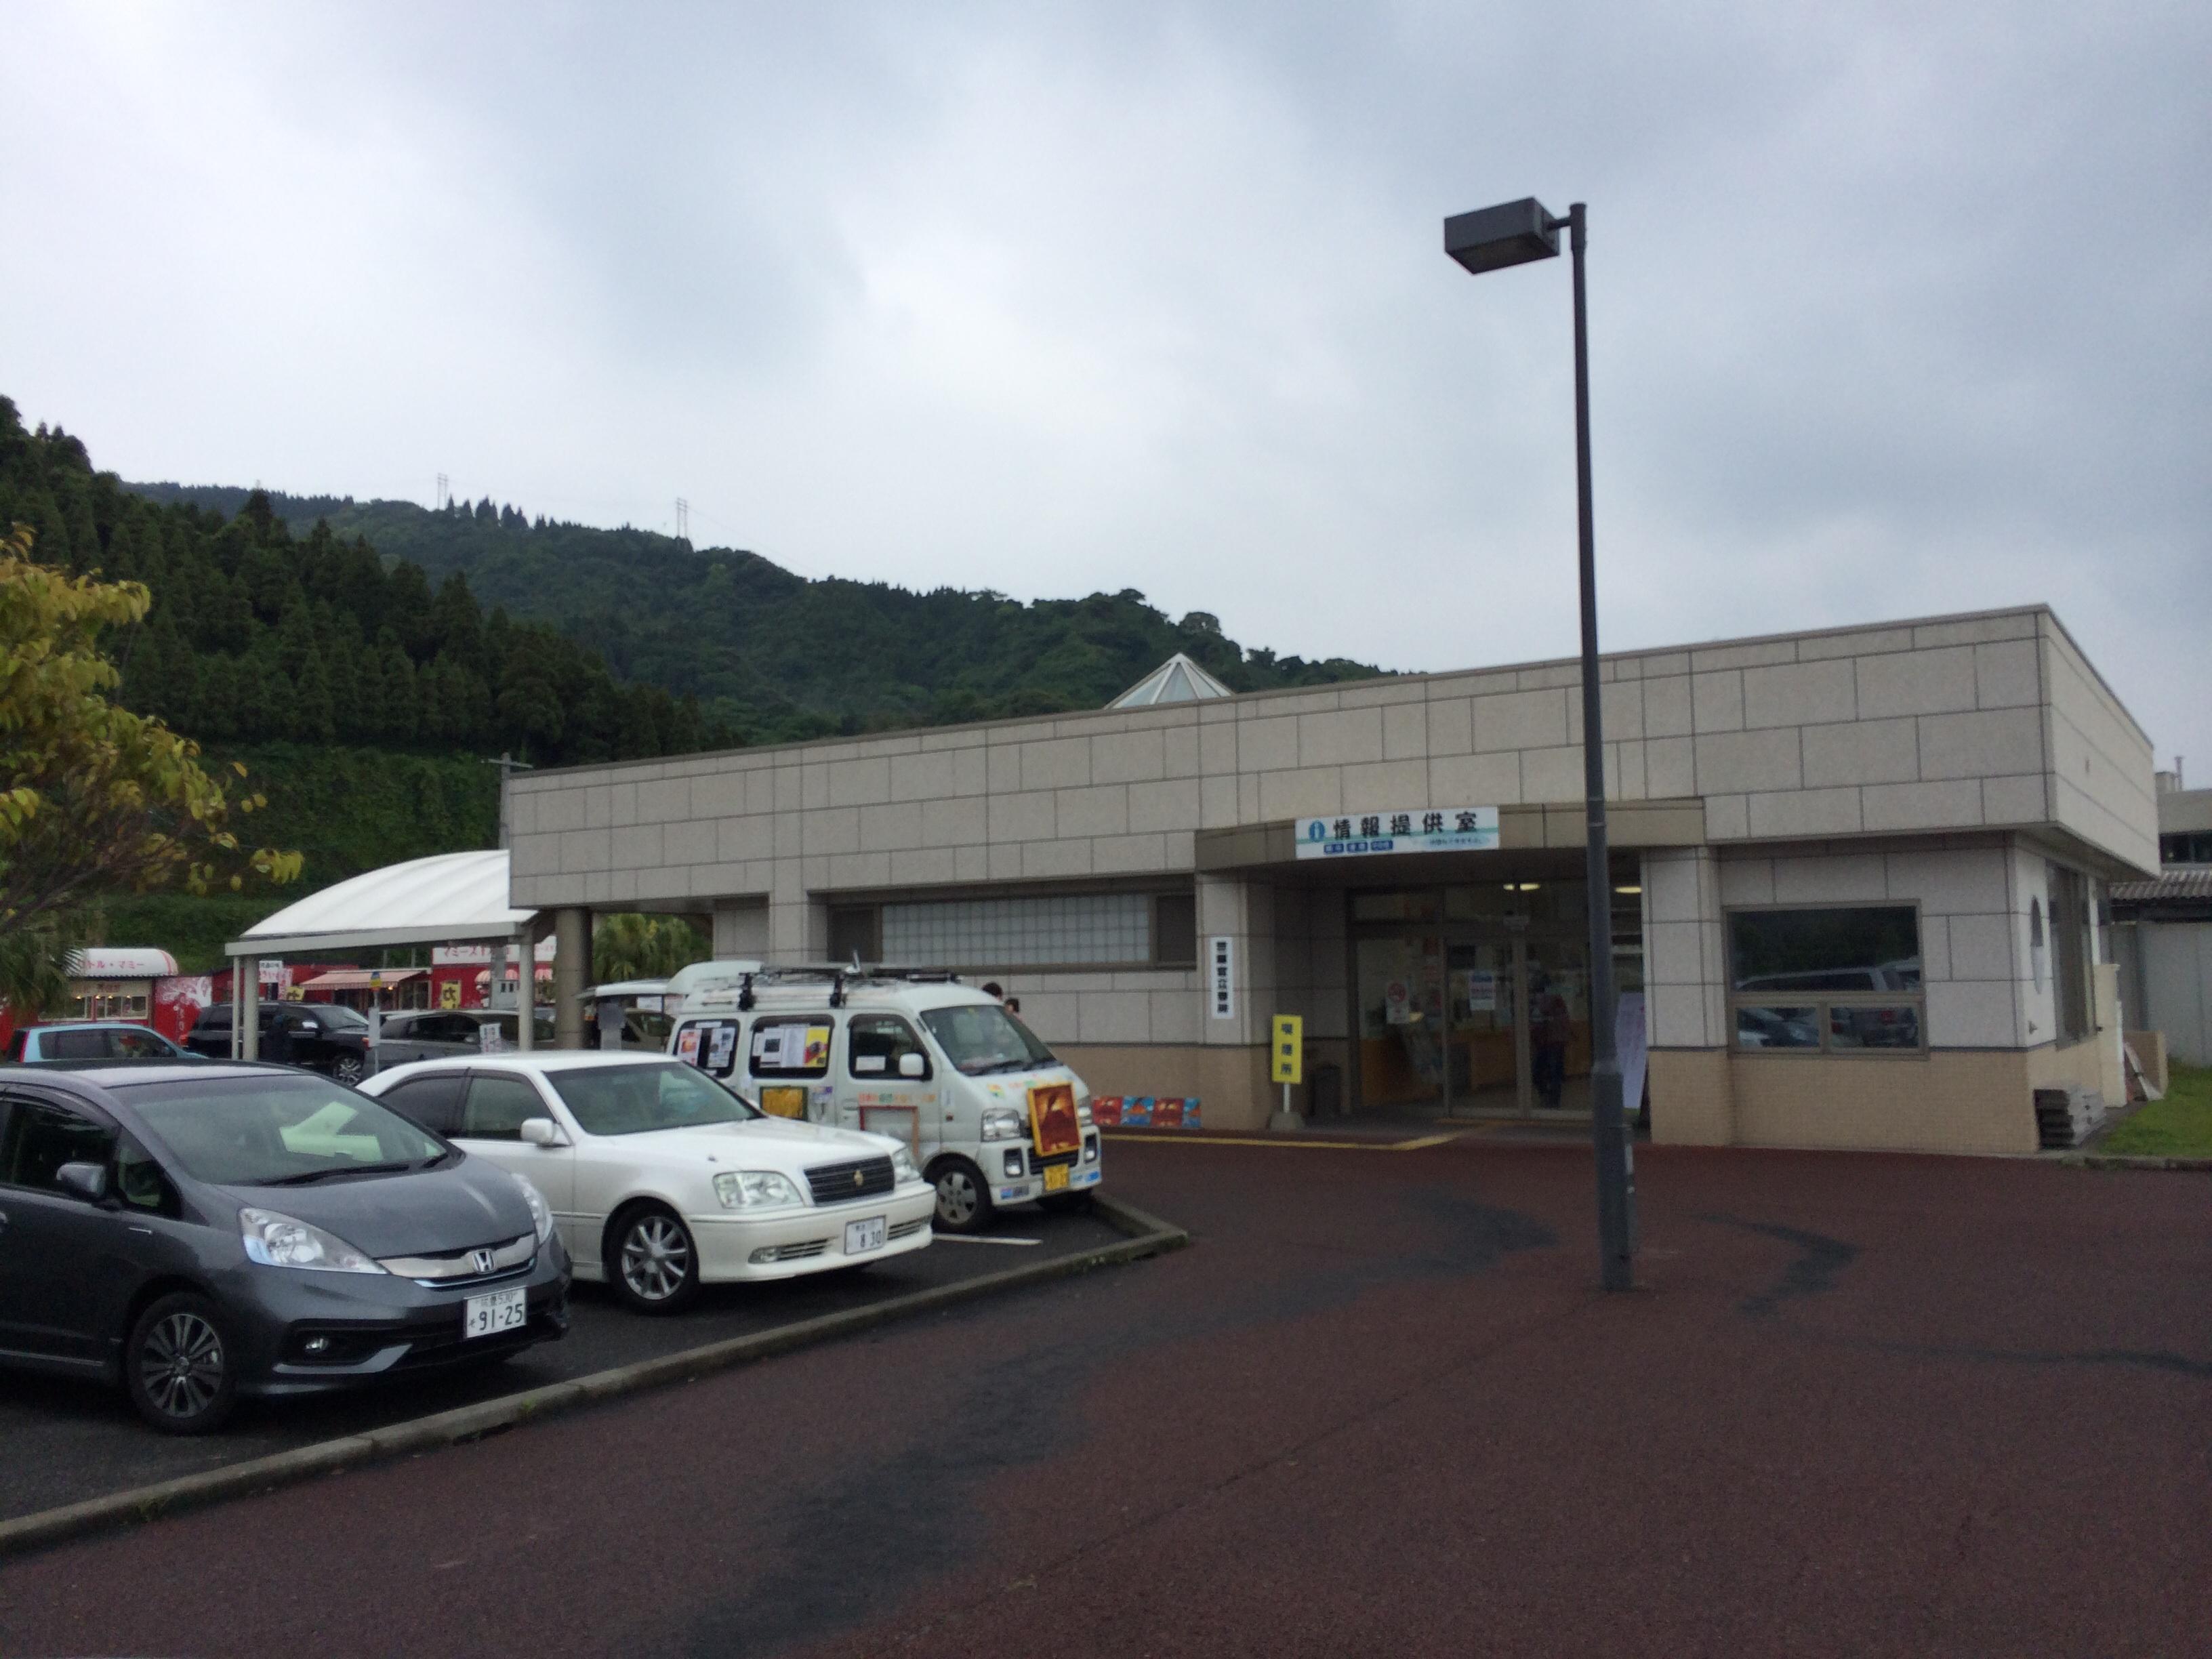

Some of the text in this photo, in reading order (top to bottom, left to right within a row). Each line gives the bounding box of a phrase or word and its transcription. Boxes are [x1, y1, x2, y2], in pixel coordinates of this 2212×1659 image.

[1333, 811, 1477, 840] 情報提供室
[479, 1303, 523, 1330] 91-25
